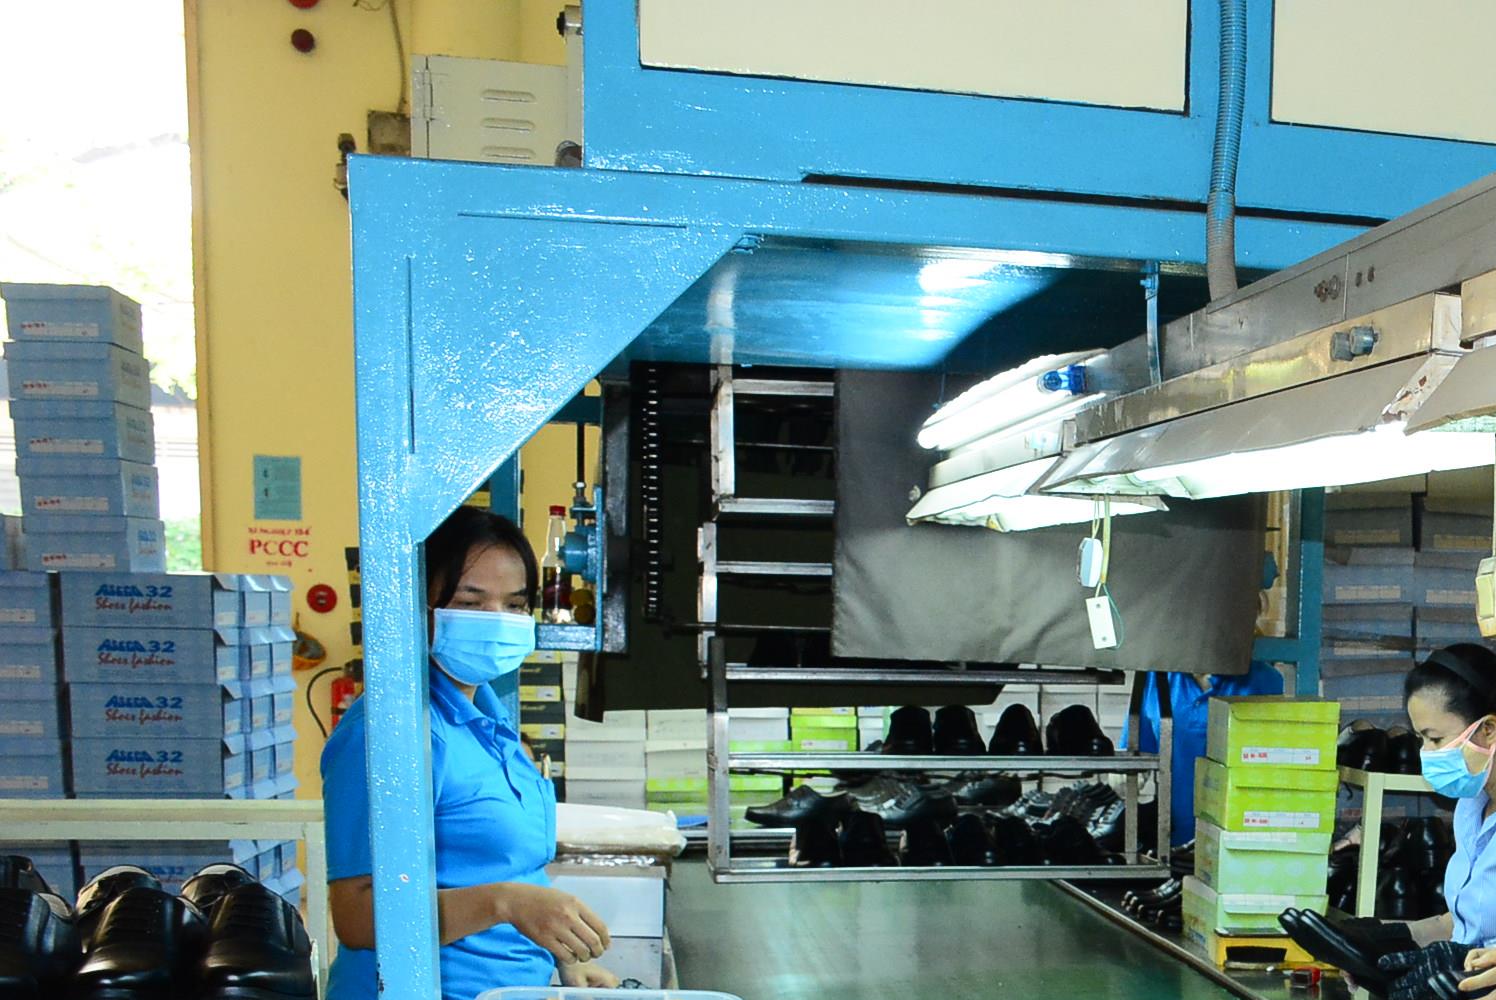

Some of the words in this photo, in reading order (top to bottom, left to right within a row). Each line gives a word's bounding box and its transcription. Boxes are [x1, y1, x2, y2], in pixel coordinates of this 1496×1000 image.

[250, 539, 309, 557] PCCC
[146, 585, 173, 598] 32
[128, 598, 173, 613] fashion
[148, 640, 176, 653] 32
[130, 652, 176, 668] fashion
[156, 696, 183, 709] 32
[139, 708, 184, 726] fashion
[156, 750, 184, 763] 32
[139, 763, 184, 778] fashion
